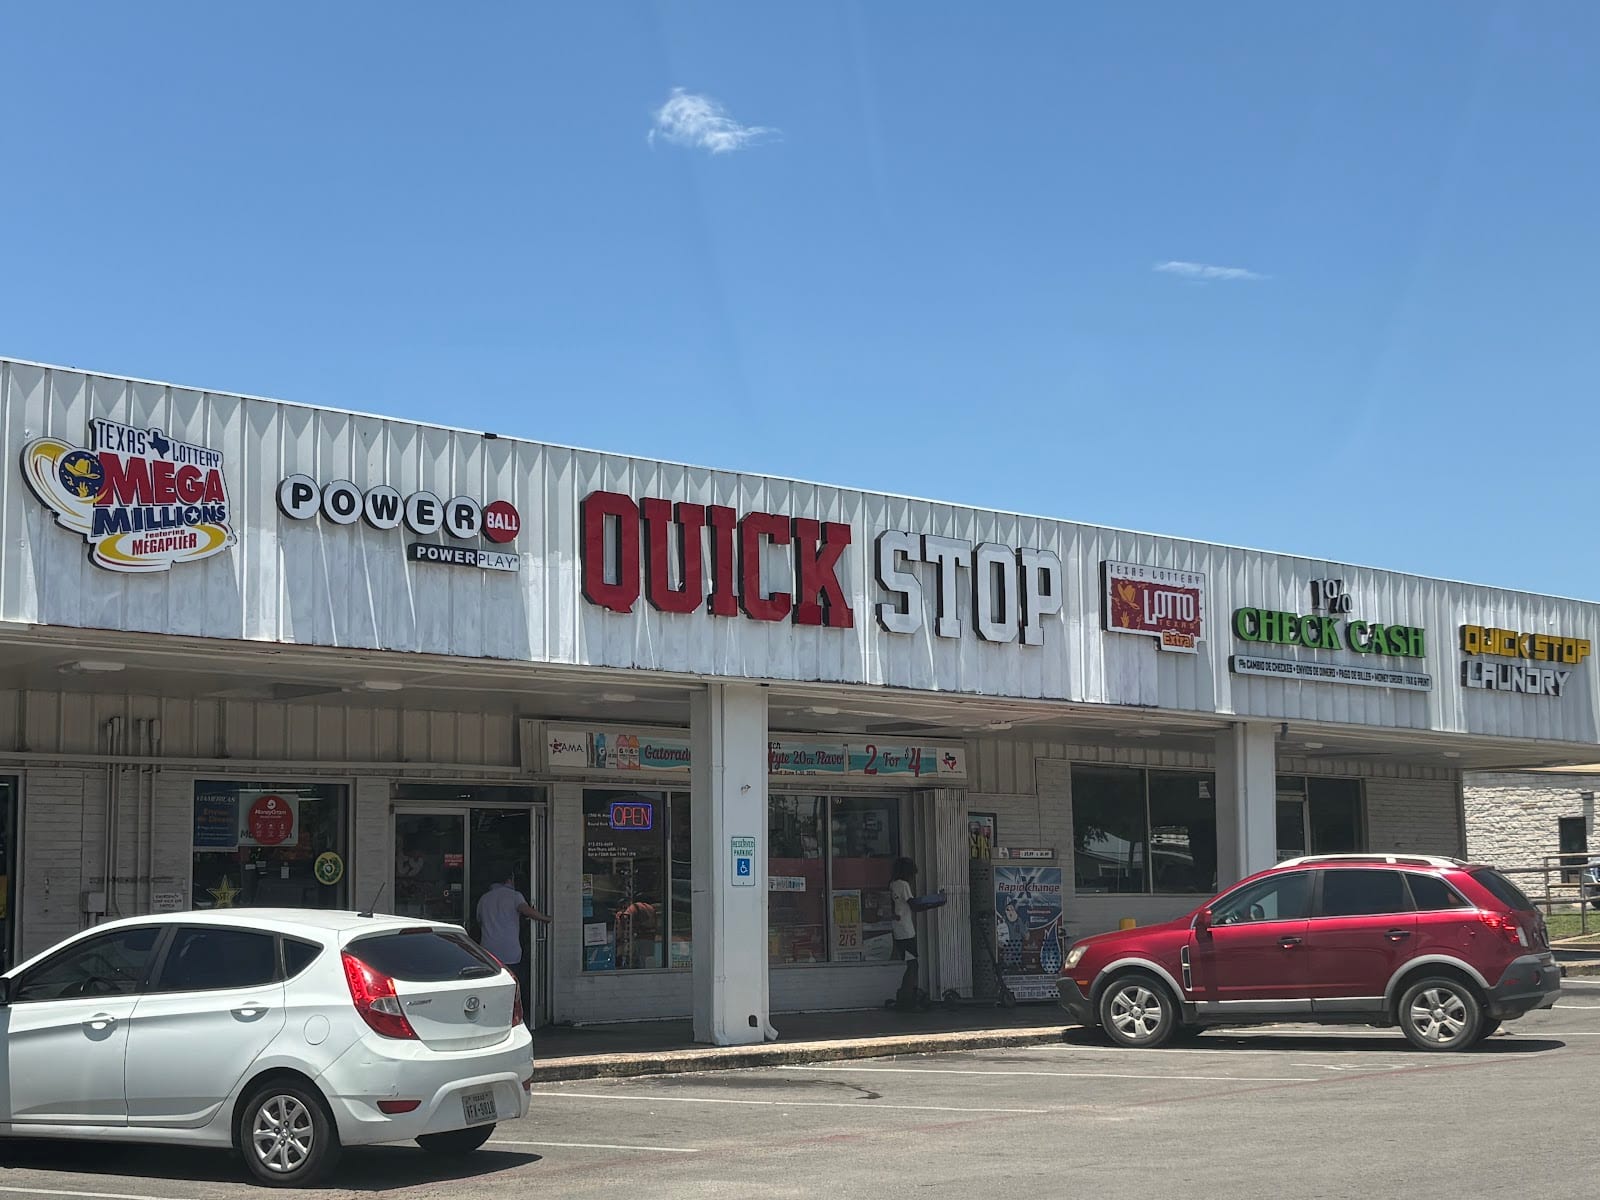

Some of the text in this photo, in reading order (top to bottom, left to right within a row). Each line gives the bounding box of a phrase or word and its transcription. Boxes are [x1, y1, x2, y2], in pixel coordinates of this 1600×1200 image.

[97, 421, 219, 467] TEXAS LOTTERY
[96, 451, 225, 507] MEGA
[91, 505, 226, 537] MILLIONS
[291, 482, 518, 531] POWER BALL
[132, 532, 197, 556] MEGAPLIER
[416, 546, 476, 565] POWER
[580, 490, 1064, 647] QUICK STOP
[1109, 564, 1201, 585] TEXAS LOTTERY
[1143, 589, 1195, 625] LOTTO
[1311, 578, 1353, 613] 1%
[1162, 631, 1195, 648] Extra!
[1233, 607, 1425, 658] CHECK CASH
[1460, 624, 1590, 664] QUICK STOP
[1247, 659, 1265, 671] CAMBIO
[1265, 662, 1271, 672] DE
[1462, 660, 1571, 697] LAUNDRY
[863, 744, 878, 775] 2
[883, 751, 900, 767] For
[613, 807, 650, 826] OPEN
